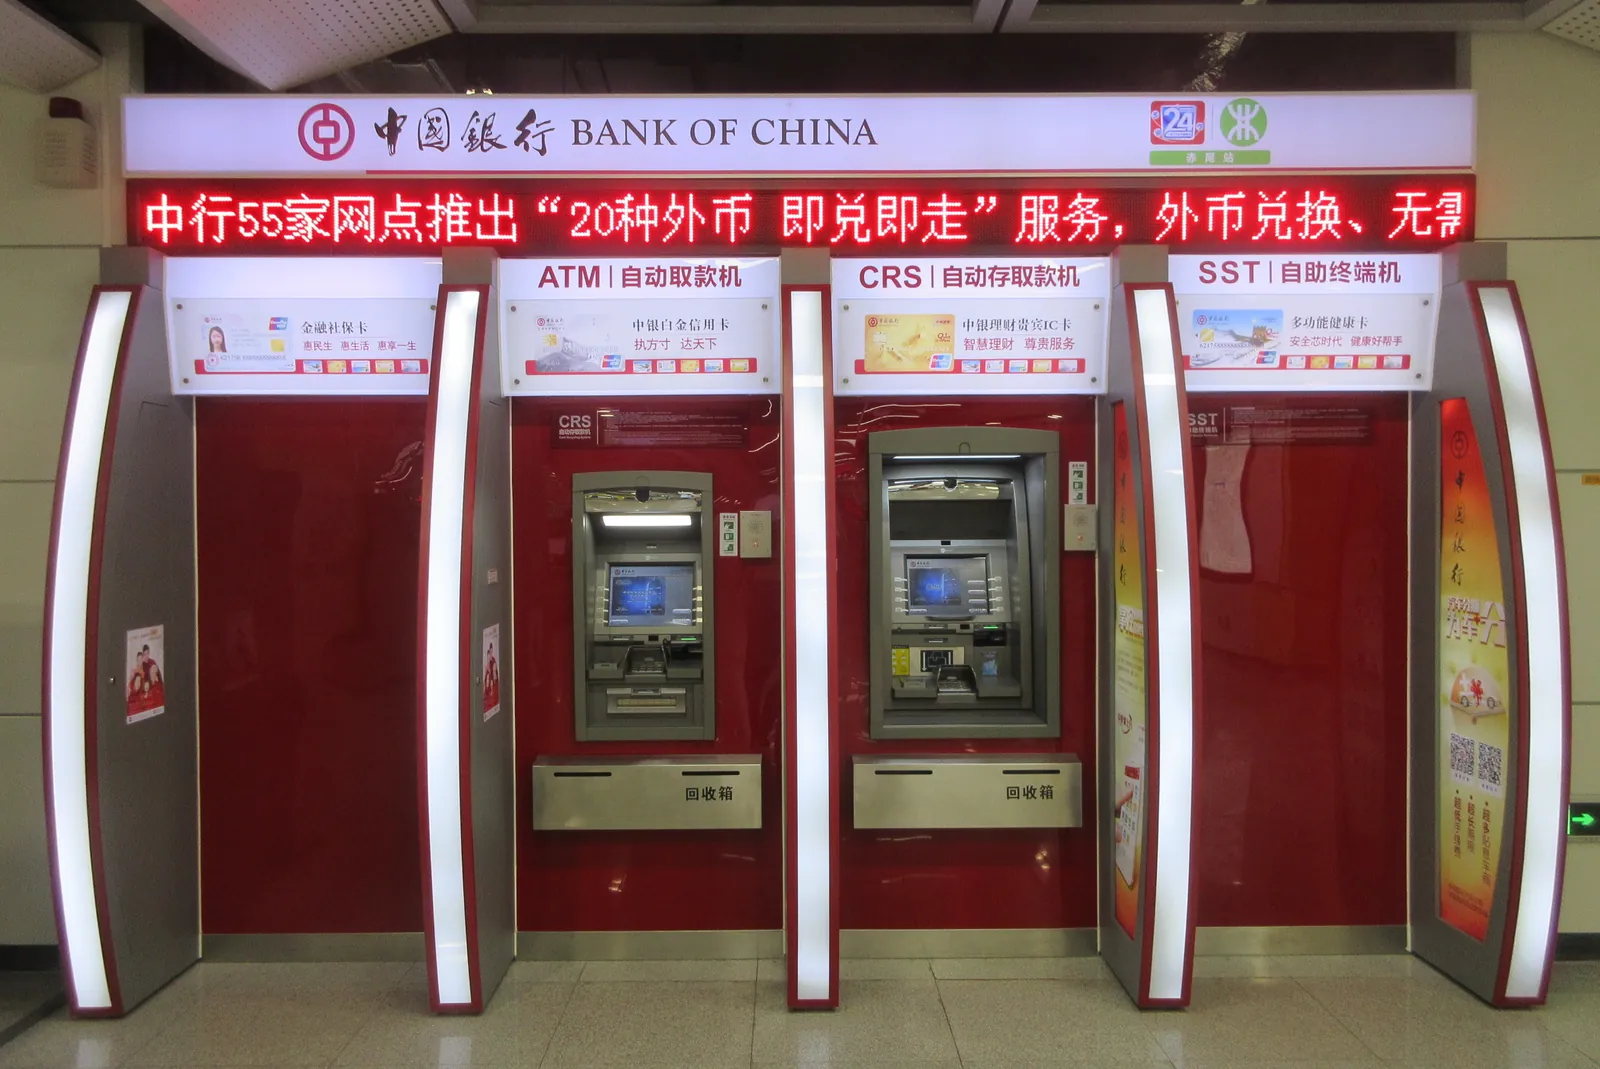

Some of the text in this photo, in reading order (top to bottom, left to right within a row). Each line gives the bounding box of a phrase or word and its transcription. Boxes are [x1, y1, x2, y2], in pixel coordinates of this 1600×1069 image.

[1163, 107, 1194, 131] 24
[571, 119, 878, 146] BANK OF CHINA
[145, 192, 518, 244] 中行55家网点推出
[538, 265, 600, 288] ATM
[622, 264, 742, 288] 自动取款机
[859, 265, 922, 289] CRS
[943, 264, 1080, 288] 自动存取款机
[1199, 260, 1260, 284] SST
[1281, 260, 1402, 284] 自助终端机
[302, 321, 368, 335] 金融社保卡
[632, 318, 730, 332] 中银白金信用卡
[963, 318, 1072, 332] 中银理财贵宾IC卡
[1292, 316, 1369, 330] 多功能健康卡
[303, 340, 416, 351] 惠民生 惠生活 惠享一生
[634, 337, 717, 351] 执方寸 达天下
[963, 337, 1015, 351] 智慧理财
[1024, 336, 1075, 351] 尊贵服务
[1290, 335, 1403, 347] 安全芯时代 健康好帮手
[558, 415, 592, 428] CRS
[1187, 413, 1218, 426] SST
[685, 785, 733, 802] 回收箱
[1006, 785, 1054, 800] 回收箱
